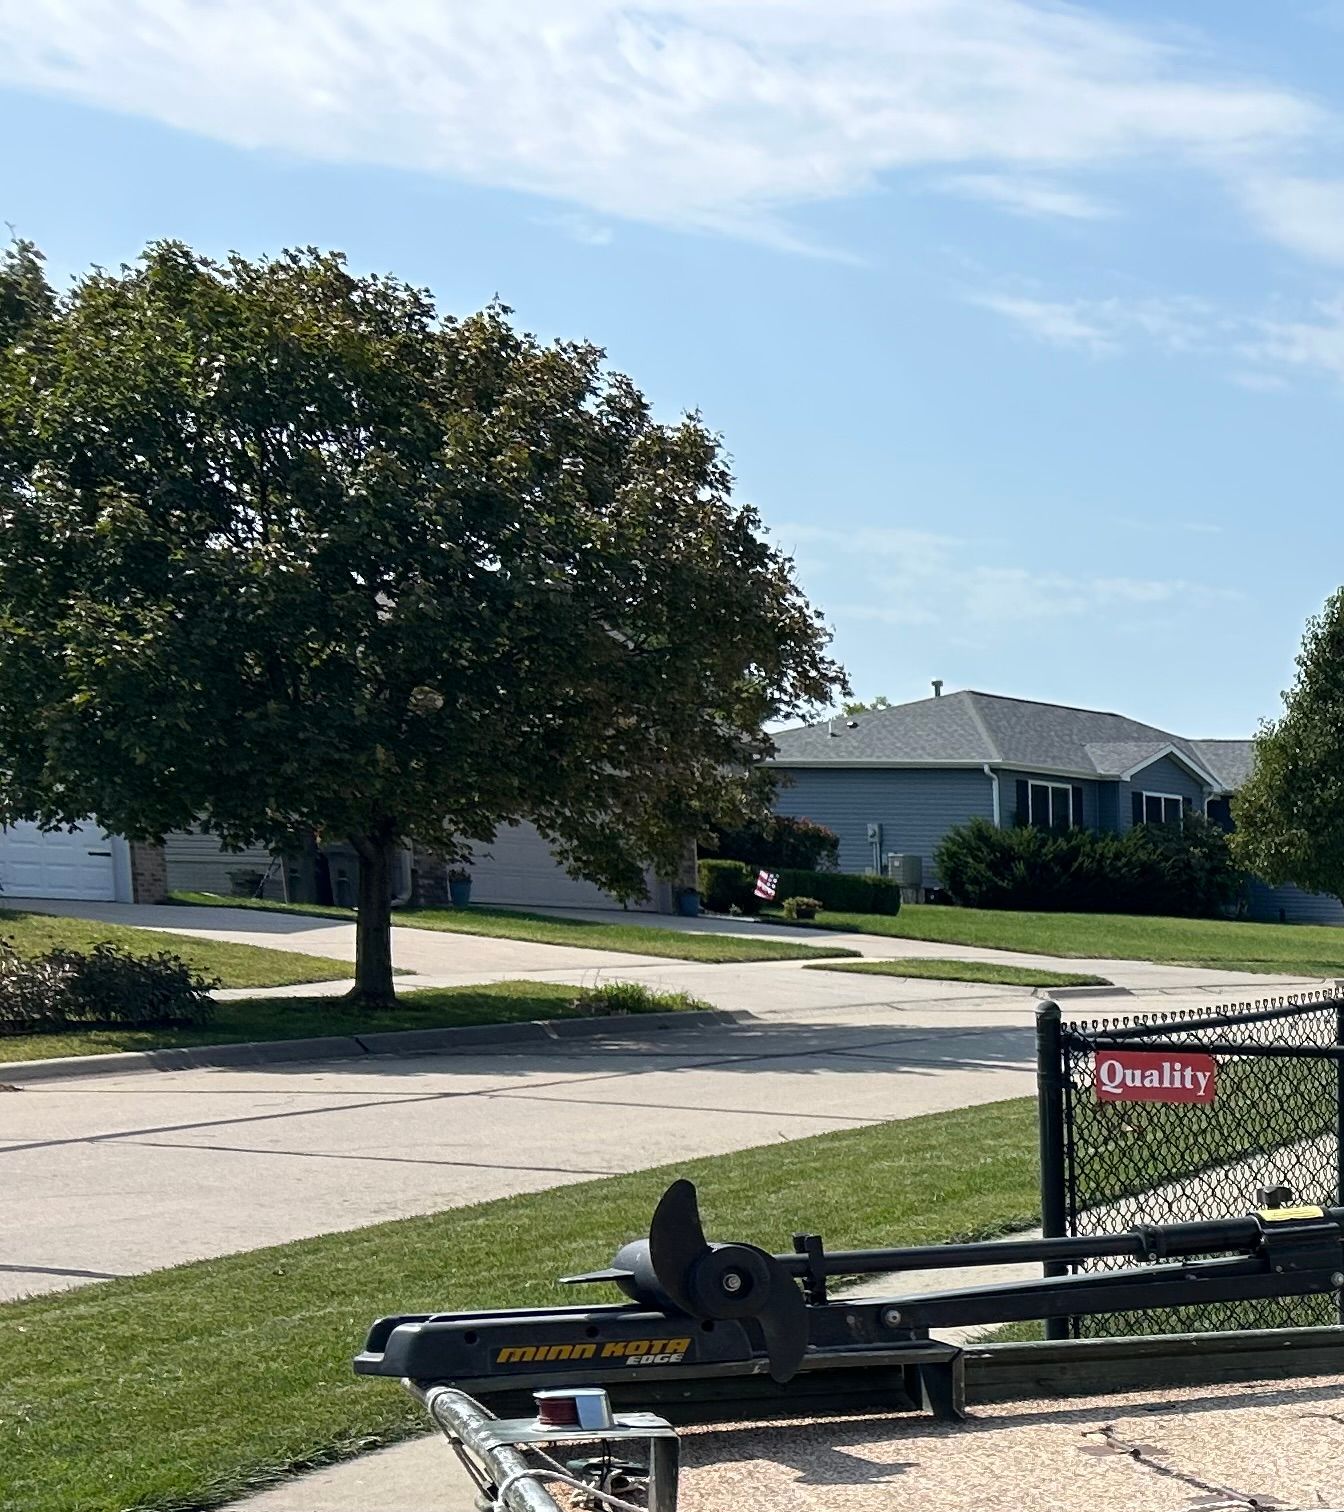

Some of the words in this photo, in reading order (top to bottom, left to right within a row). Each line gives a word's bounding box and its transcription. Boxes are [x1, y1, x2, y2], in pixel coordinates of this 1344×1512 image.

[1100, 1060, 1211, 1096] Quality
[496, 1343, 597, 1364] MINN
[601, 1338, 691, 1358] KOTA
[625, 1352, 685, 1366] EDGE
